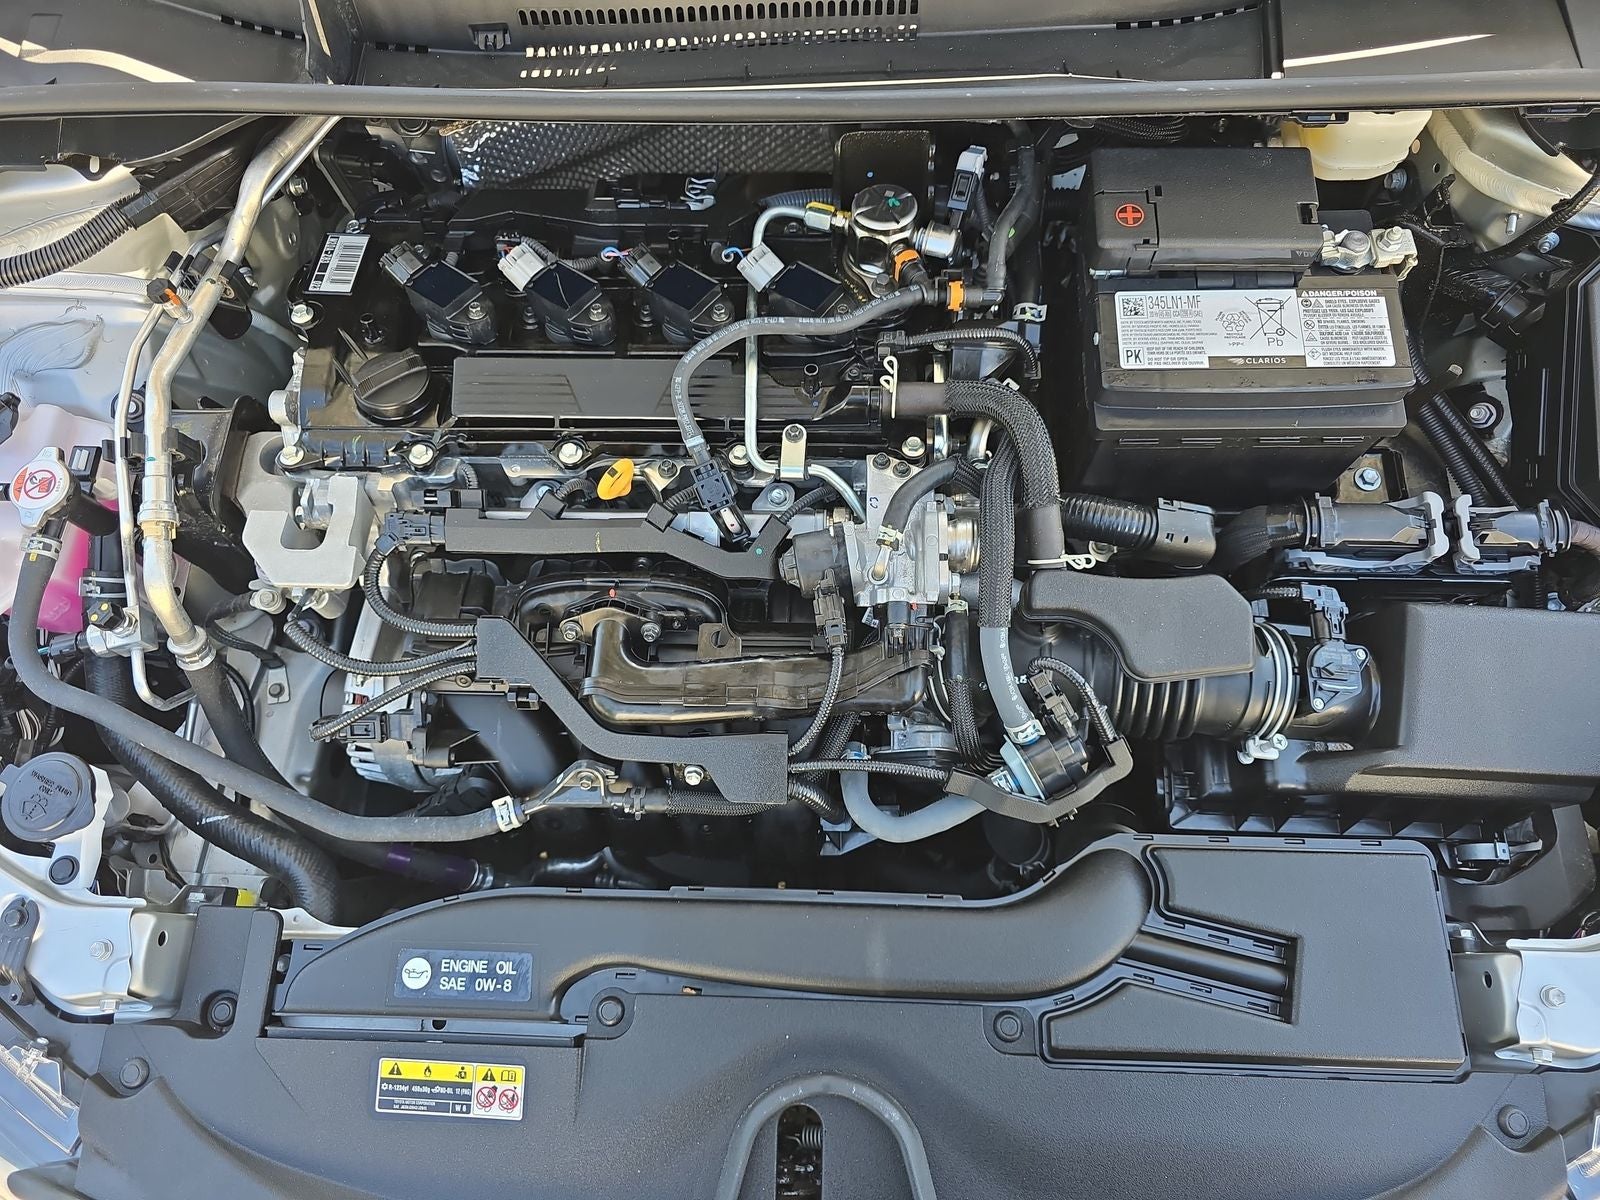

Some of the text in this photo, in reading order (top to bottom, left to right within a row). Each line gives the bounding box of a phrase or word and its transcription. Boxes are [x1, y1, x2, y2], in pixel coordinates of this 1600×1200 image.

[1147, 295, 1201, 310] 345LN1-MF
[1267, 337, 1284, 347] Pb
[1125, 349, 1142, 364] PK
[440, 959, 517, 975] ENGINE OIL
[439, 976, 512, 993] SAE 0W-8
